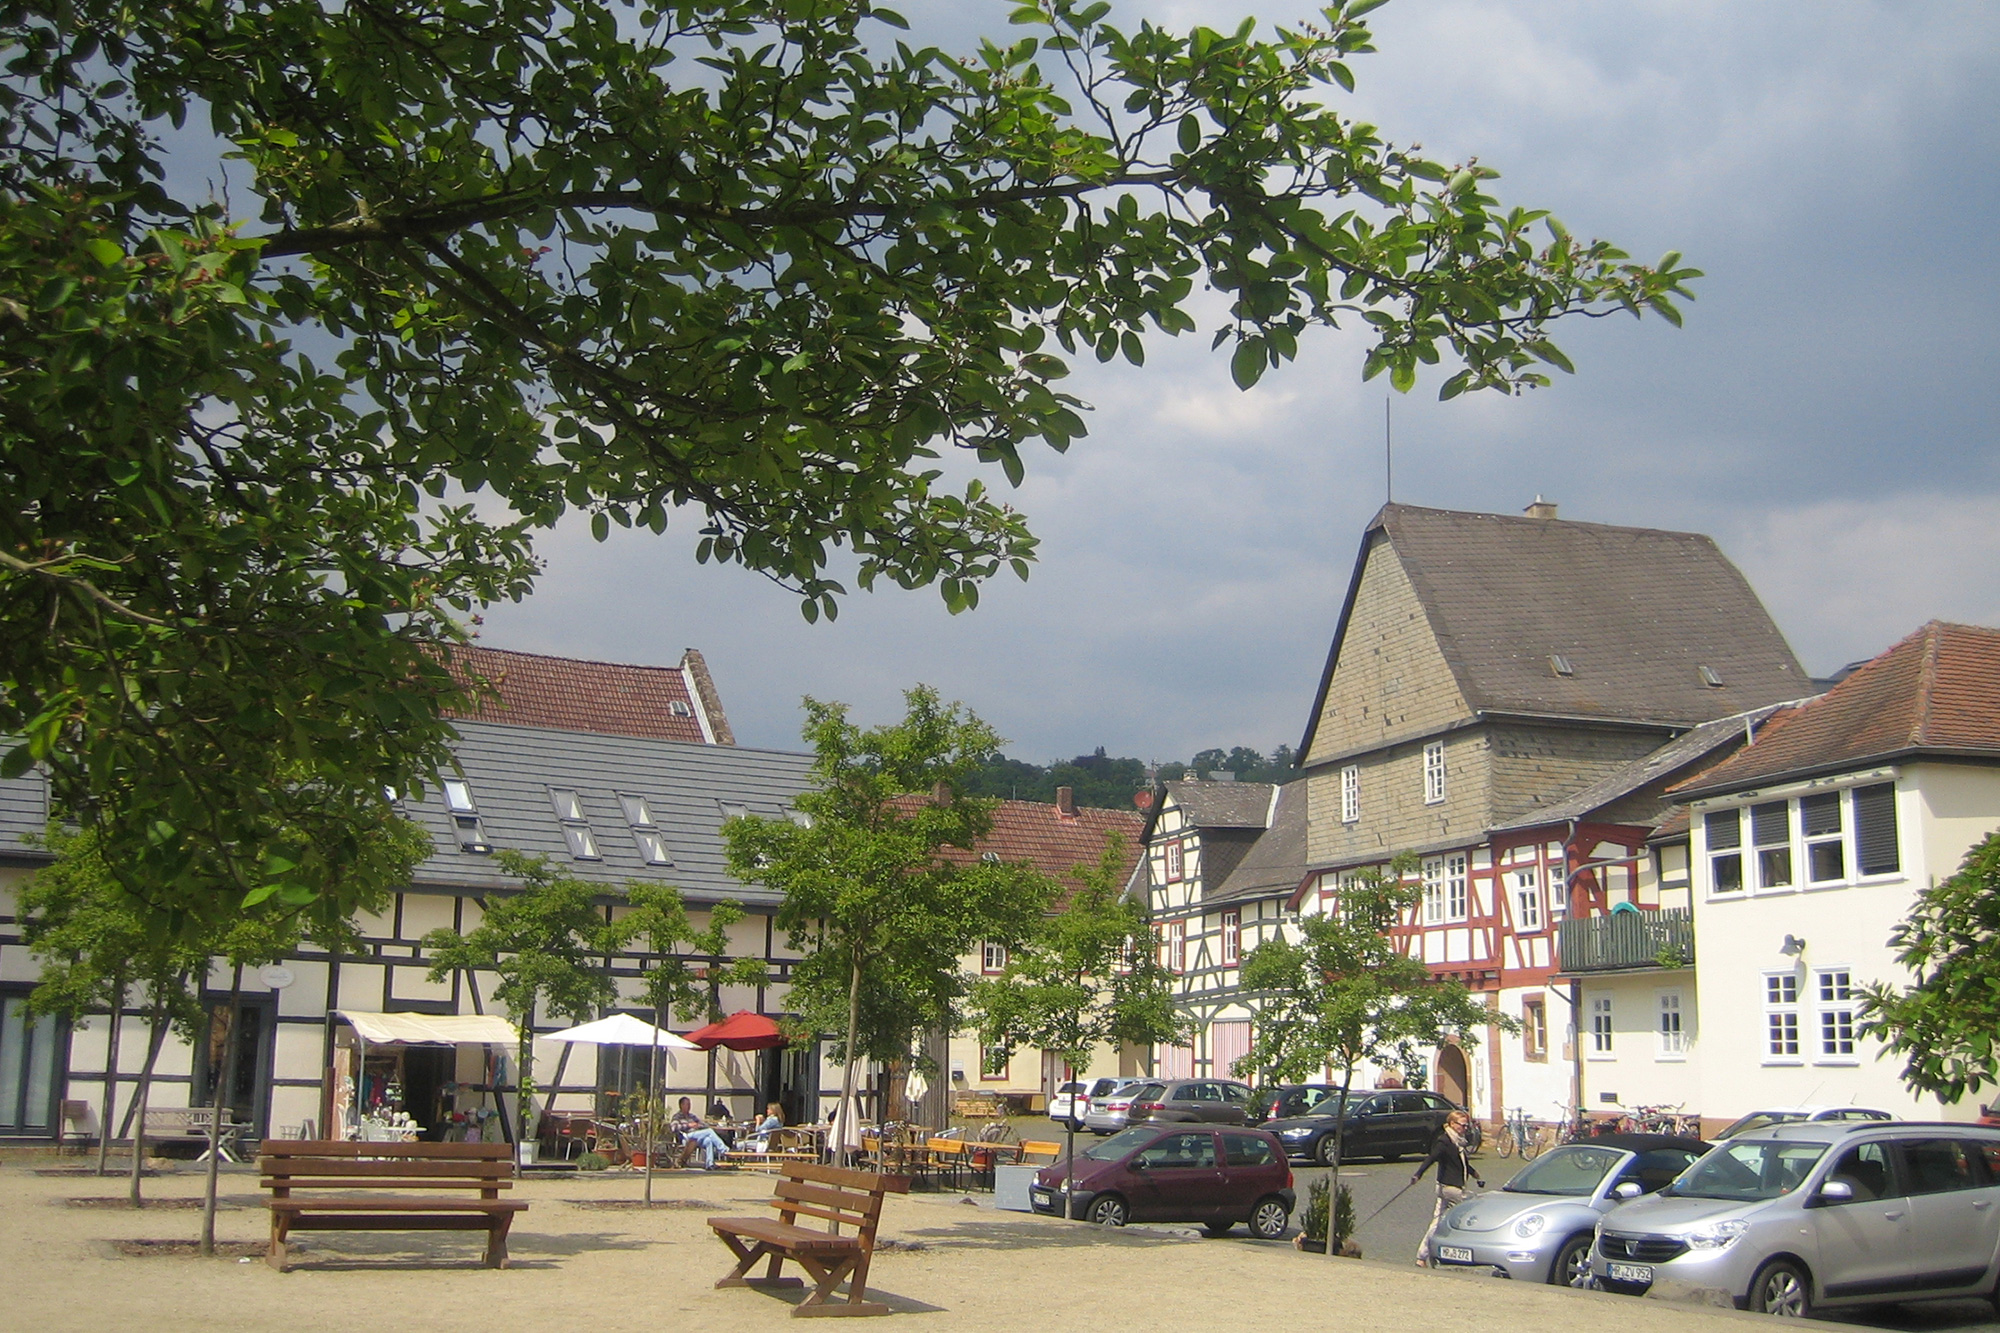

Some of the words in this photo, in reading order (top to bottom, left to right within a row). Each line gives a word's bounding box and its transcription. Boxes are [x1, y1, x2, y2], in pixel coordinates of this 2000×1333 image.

[1612, 1265, 1621, 1276] HR
[1625, 1266, 1634, 1278] ZV
[1636, 1267, 1651, 1279] 952
